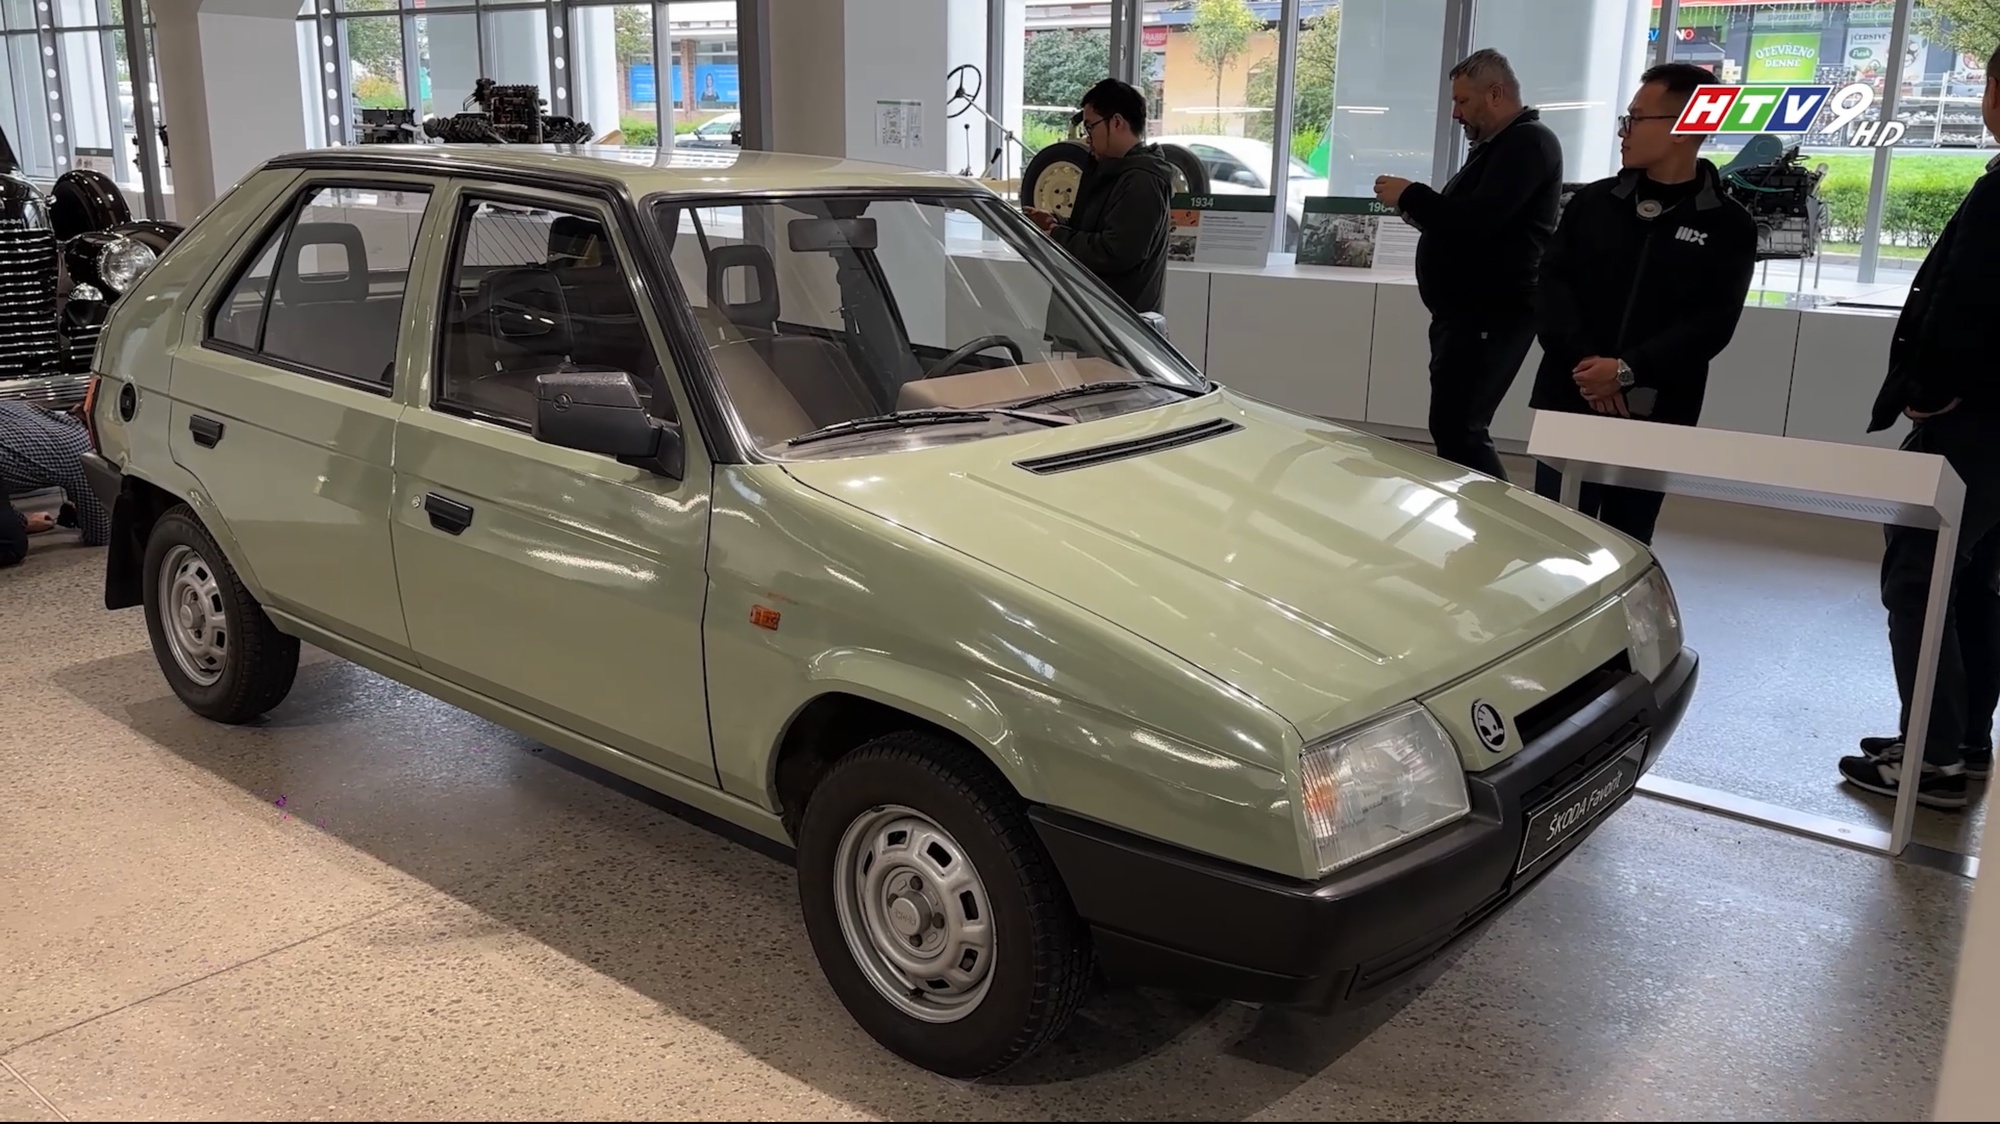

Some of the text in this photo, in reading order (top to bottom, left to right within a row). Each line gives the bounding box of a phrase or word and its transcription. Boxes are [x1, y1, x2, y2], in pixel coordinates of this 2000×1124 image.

[1755, 43, 1816, 60] OTEVŘENO
[1190, 196, 1215, 208] 1934
[1546, 769, 1623, 841] ŠKODA Favorit
